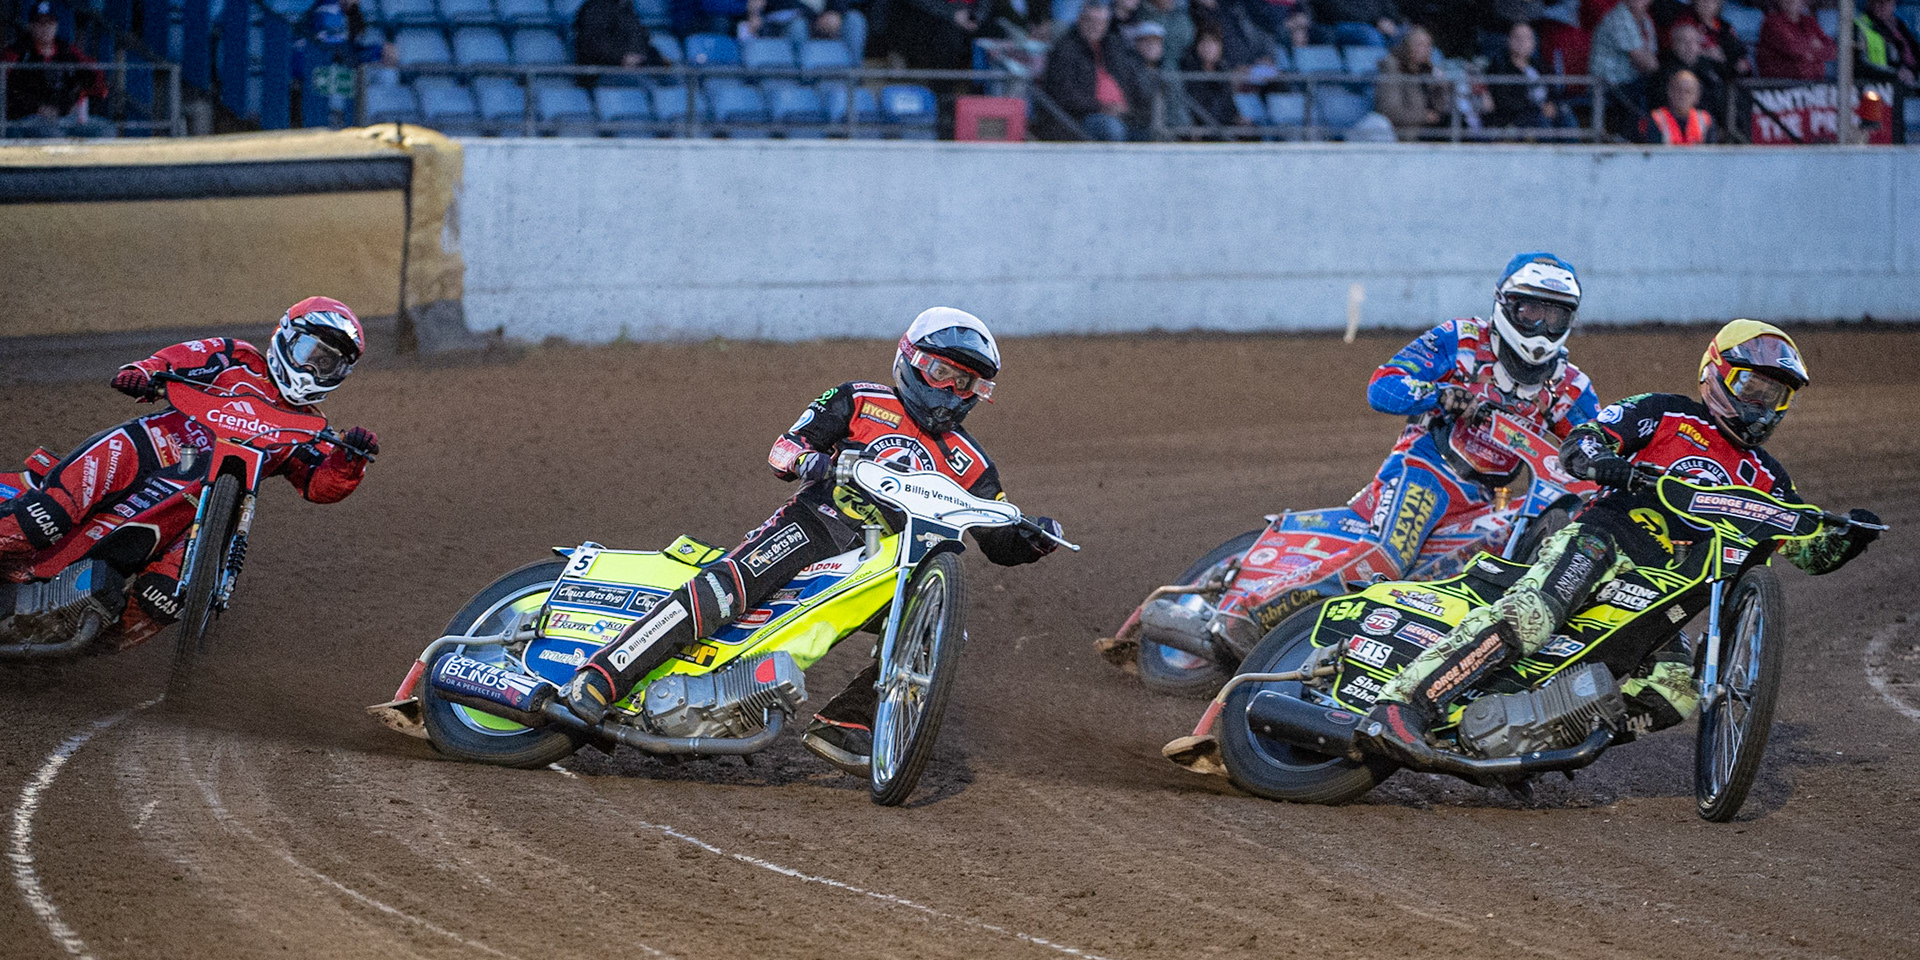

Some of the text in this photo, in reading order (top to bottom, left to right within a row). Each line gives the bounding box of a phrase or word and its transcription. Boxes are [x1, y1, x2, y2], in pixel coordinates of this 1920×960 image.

[861, 402, 901, 424] HYCOTE
[206, 409, 281, 439] Crendon
[218, 423, 238, 432] TIMBER
[873, 438, 902, 452] BELLE
[906, 440, 924, 457] VUE
[952, 451, 967, 470] 5
[1675, 460, 1724, 480] BELLE VUE
[1695, 495, 1744, 509] GEORGE
[27, 502, 57, 536] LUCAS
[1389, 482, 1424, 551] KEVIN
[1729, 508, 1750, 517] SON
[1401, 488, 1437, 565] MOORE
[751, 550, 773, 568] Claus
[787, 530, 804, 546] Byg
[574, 555, 593, 571] 5
[559, 588, 586, 598] Claus
[1623, 581, 1659, 600] KING
[142, 585, 179, 617] LUCAS
[635, 597, 656, 608] Clau
[1613, 591, 1652, 610] DICK
[1327, 602, 1367, 621] #34
[1366, 615, 1398, 628] STS
[1360, 640, 1391, 661] FTS
[1459, 633, 1502, 671] HEPBURN
[445, 664, 511, 691] BLINDS
[1453, 671, 1470, 686] SON
[462, 682, 491, 698] PERFECT
[491, 690, 501, 699] FIT
